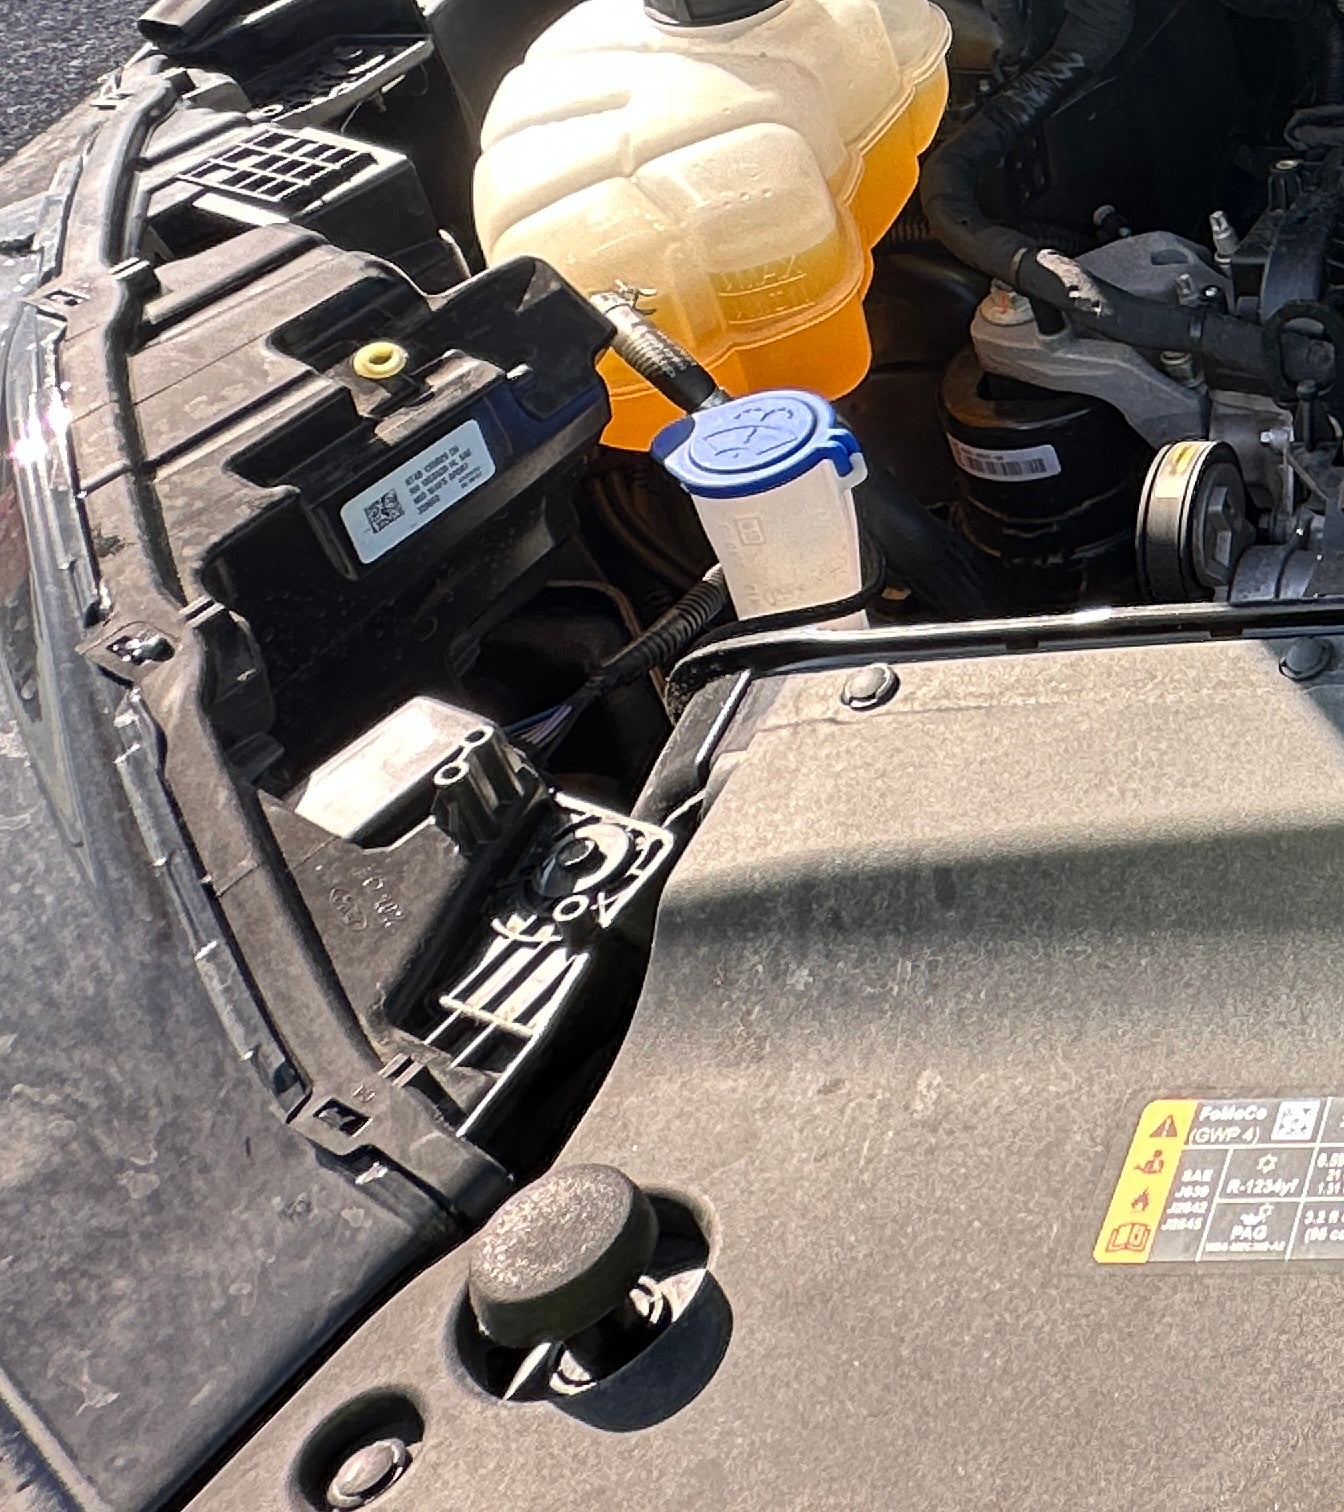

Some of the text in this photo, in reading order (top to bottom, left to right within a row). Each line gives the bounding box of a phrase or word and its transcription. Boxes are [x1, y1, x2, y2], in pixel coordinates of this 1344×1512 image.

[1189, 1126, 1260, 1145] (GWP 4)
[1226, 1179, 1300, 1196] R-1234yf
